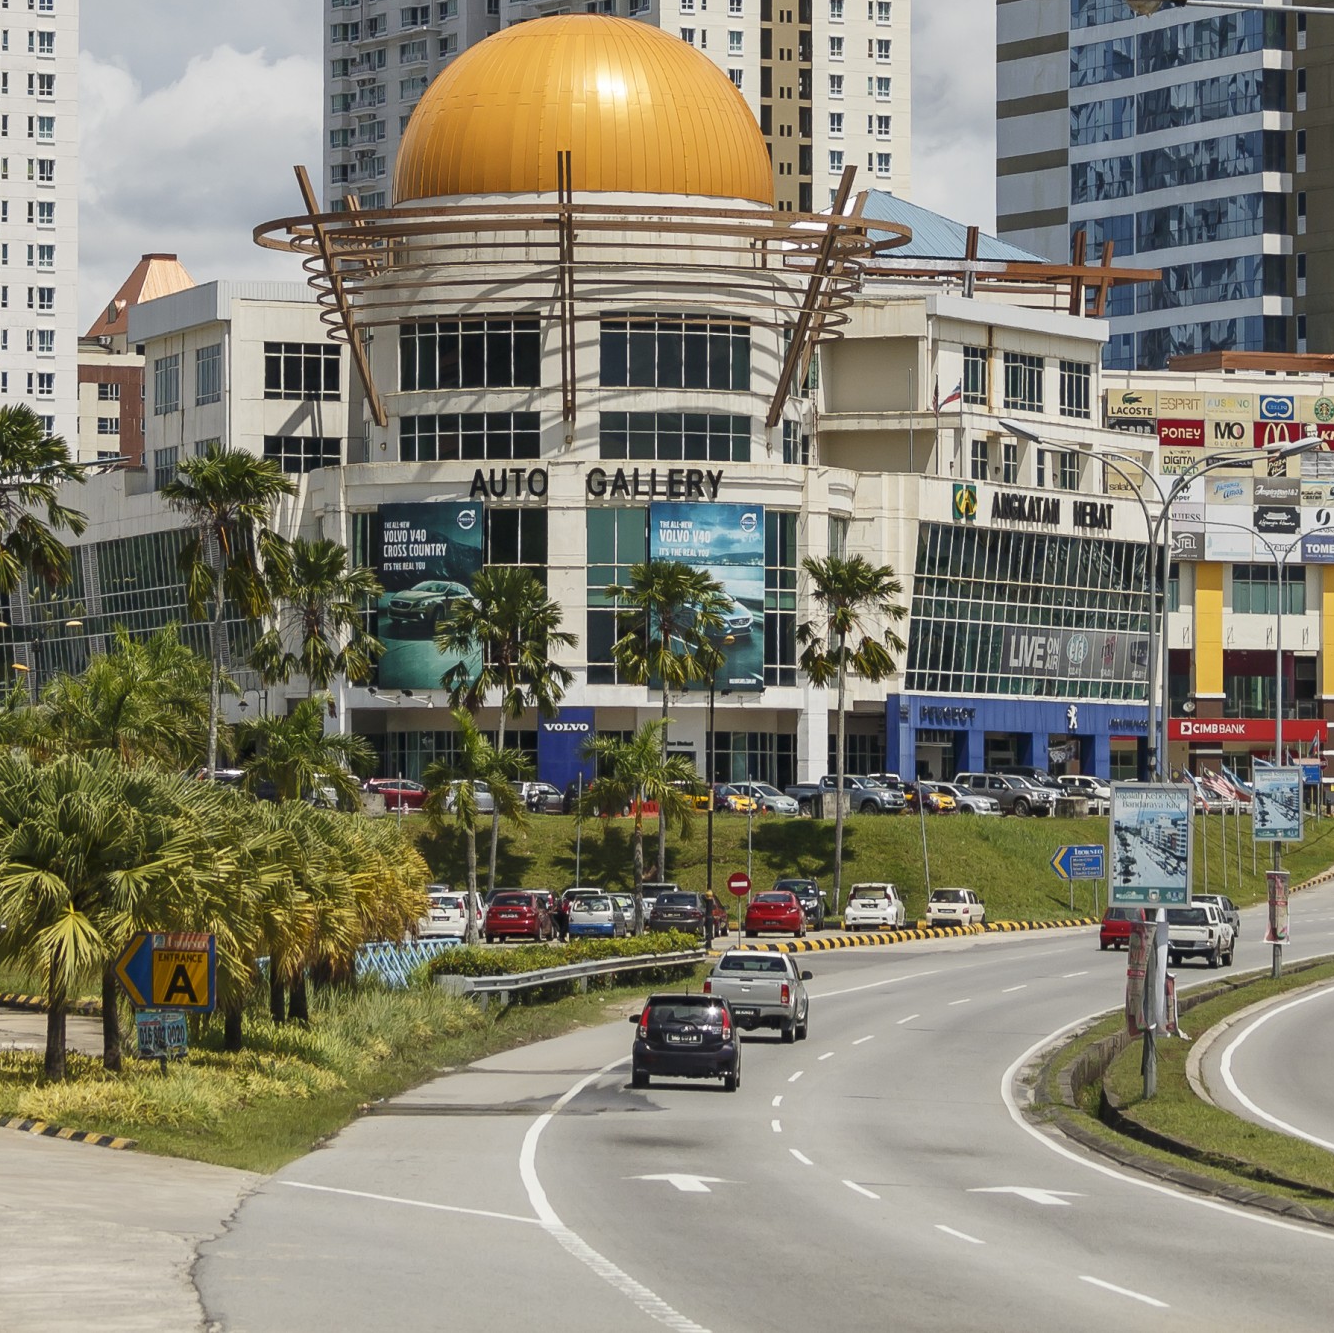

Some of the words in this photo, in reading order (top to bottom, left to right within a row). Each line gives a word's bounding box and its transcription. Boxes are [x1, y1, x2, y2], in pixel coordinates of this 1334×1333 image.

[1111, 406, 1153, 415] LACOSTE
[1160, 397, 1201, 411] ESPRIT
[1161, 427, 1201, 440] PONEY
[1214, 421, 1245, 440] MO
[469, 468, 549, 498] AUTO
[586, 467, 723, 498] GALLERY
[991, 492, 1061, 525] ANGKATAN
[1073, 501, 1114, 530] HEBAT
[383, 529, 408, 543] VOLVO
[410, 529, 427, 542] V40
[659, 529, 690, 543] VOLVO
[692, 530, 711, 544] V40
[383, 544, 408, 558] CROSS
[409, 543, 447, 557] COUNTRY
[671, 548, 682, 556] THE
[682, 548, 697, 557] REAL
[698, 548, 710, 557] YOU
[393, 562, 402, 571] THE
[402, 562, 415, 571] REAL
[415, 561, 426, 570] YOU
[1009, 635, 1046, 668] LIVE
[1046, 637, 1060, 654] ON
[1044, 655, 1059, 670] AIR
[543, 722, 589, 732] VOLVO
[1192, 723, 1218, 734] CIMB
[1219, 724, 1246, 734] BANK
[158, 952, 203, 963] ENTRANCE
[163, 963, 199, 1003] A
